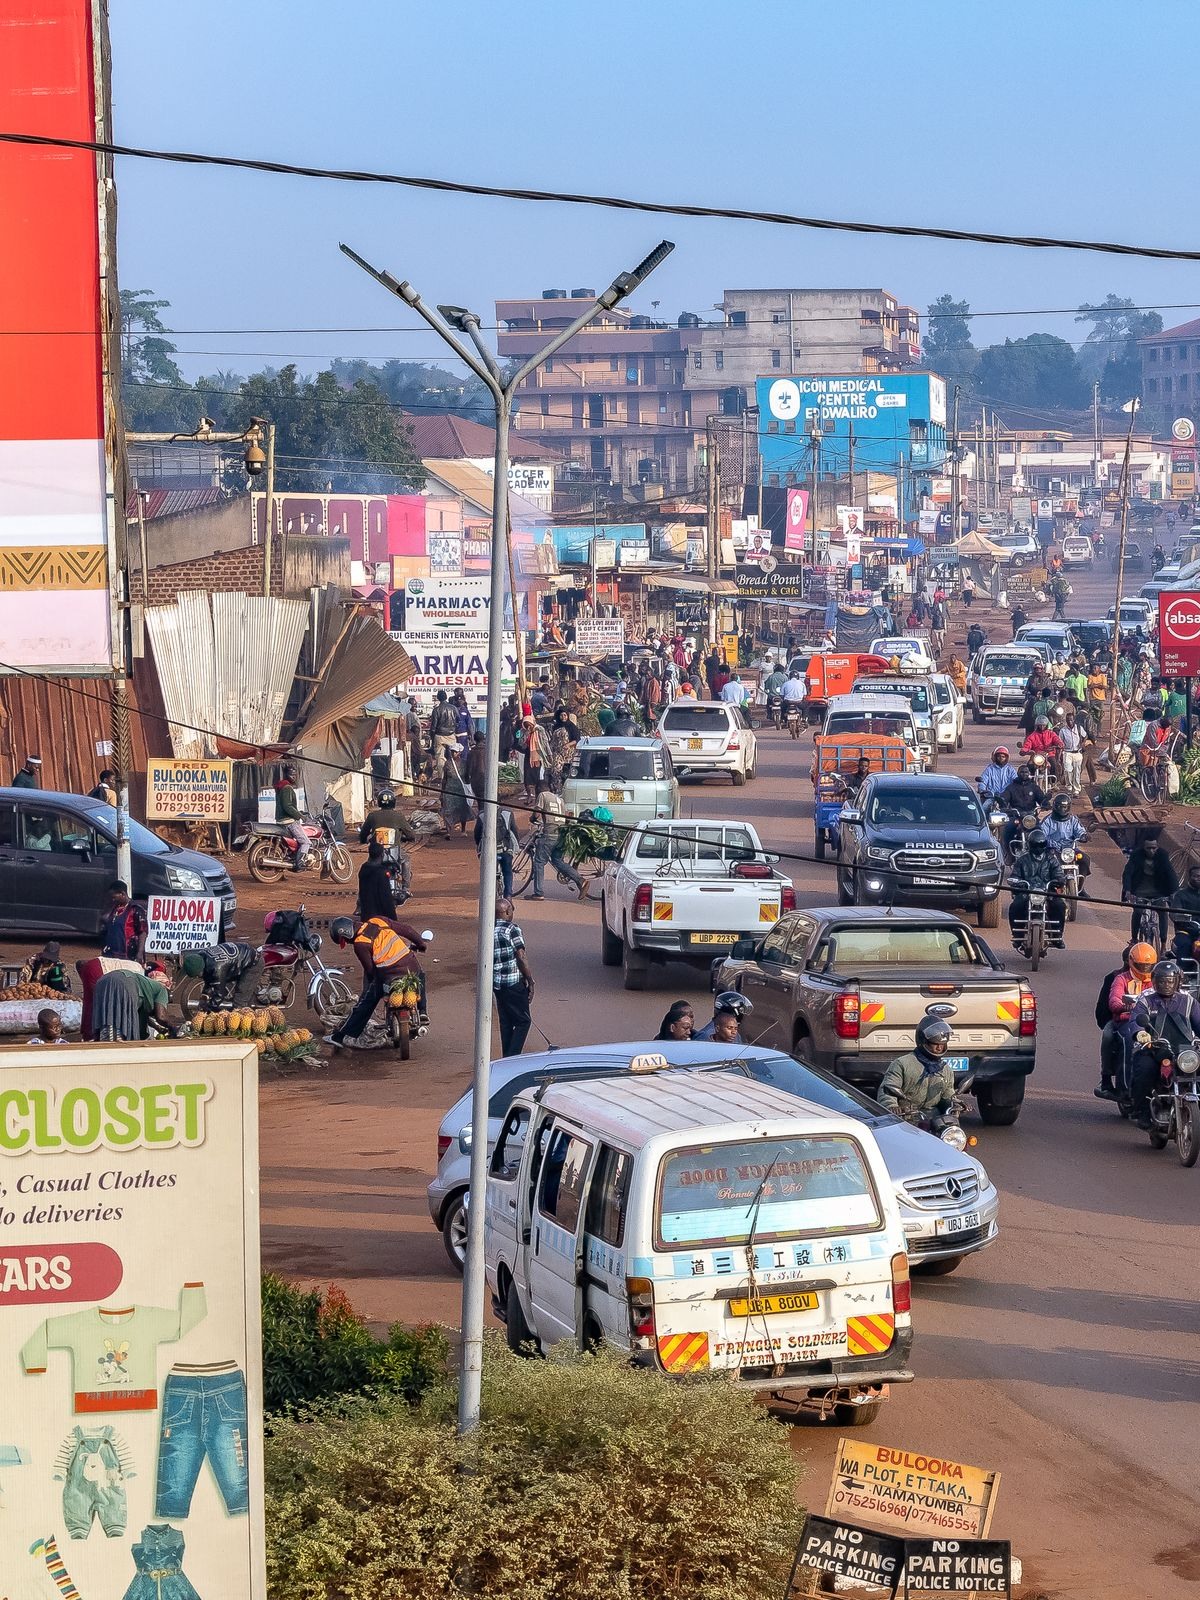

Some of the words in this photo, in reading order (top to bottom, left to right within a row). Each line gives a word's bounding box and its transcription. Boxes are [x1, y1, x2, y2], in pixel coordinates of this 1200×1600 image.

[800, 380, 826, 393] ICON
[829, 379, 884, 393] MEDICAL
[818, 393, 866, 406] CENTRE
[507, 470, 544, 478] OCCER
[508, 480, 549, 488] CADEMY
[737, 574, 768, 585] Bread
[771, 574, 800, 585] Point
[739, 587, 768, 597] Bakery
[406, 597, 492, 609] PHARMACY
[408, 677, 489, 685] WHOLESALE
[154, 769, 207, 783] BULOOKA
[211, 770, 227, 783] WA
[192, 784, 227, 792] NAMAYUMBA
[156, 793, 224, 802] 0700108042
[156, 803, 224, 812] 0782973612
[152, 899, 214, 923] BULOOKA
[150, 922, 160, 930] WA
[164, 922, 189, 931] POLOTI
[192, 923, 217, 932] ETTAKA
[150, 941, 171, 950] 0700
[636, 1055, 663, 1067] TAXI
[0, 1083, 208, 1150] CLOSET
[16, 1172, 92, 1194] Casual
[98, 1169, 178, 1191] Clothes
[22, 1202, 124, 1224] deliveries
[948, 1217, 962, 1231] UBJ
[779, 1296, 811, 1309] 800V
[876, 1447, 963, 1479] BULOOKA
[839, 1457, 859, 1476] WA
[863, 1464, 902, 1489] PLOT,
[905, 1473, 973, 1503] ETTAKA,
[872, 1484, 964, 1516] NAMAYUMBA
[834, 1526, 864, 1544] NO
[932, 1540, 960, 1553] NO
[806, 1536, 897, 1572] PARKING
[800, 1552, 843, 1574] POLICE
[846, 1565, 892, 1586] NOTICE
[908, 1556, 1004, 1575] PARKING
[906, 1575, 950, 1590] POLICE
[955, 1576, 1006, 1591] NOTICE
